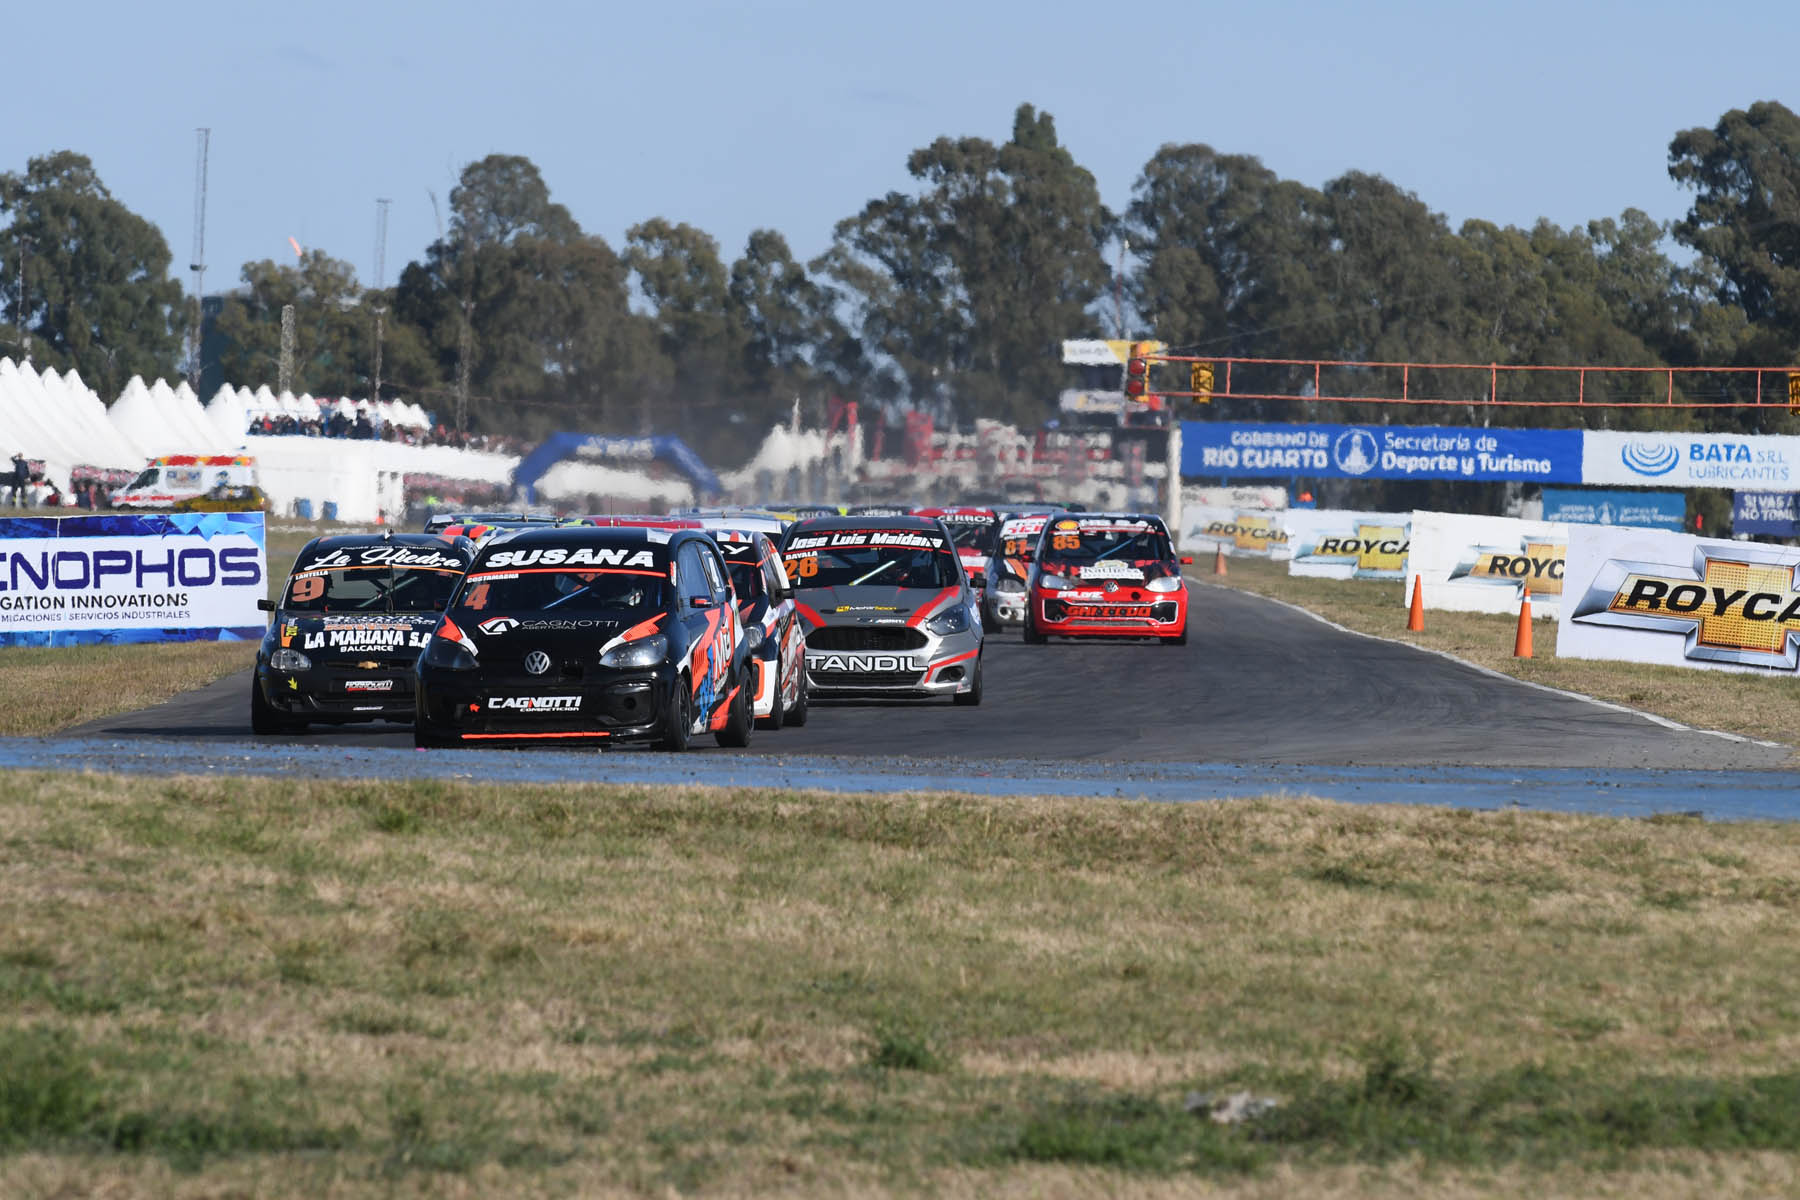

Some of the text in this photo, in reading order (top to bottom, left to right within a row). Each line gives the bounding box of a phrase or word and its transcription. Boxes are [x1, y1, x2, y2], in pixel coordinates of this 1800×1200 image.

[1308, 433, 1329, 448] DE
[1475, 435, 1498, 452] de
[1242, 449, 1328, 468] CUARTO
[1689, 443, 1752, 462] BATA
[1381, 451, 1552, 475] Deporte y Turismo
[1688, 465, 1790, 481] LUBRICANTES
[1758, 494, 1784, 509] VAS
[1738, 508, 1760, 521] NO
[787, 532, 944, 551] Jose Luis Maidana
[1052, 535, 1081, 550] 85
[304, 549, 352, 571] La
[485, 548, 654, 568] SUSANA
[0, 547, 262, 592] NOPHOS
[783, 556, 819, 581] 26
[291, 576, 325, 602] 9
[463, 583, 490, 610] 4
[72, 592, 188, 609] INNOVATIONS
[69, 611, 119, 621] SERVICIOS
[121, 610, 190, 620] INDUSTRIALES
[521, 620, 619, 628] CAGNOTTI
[304, 632, 325, 650] LA
[329, 630, 404, 647] MARIANA
[340, 645, 394, 653] BALCARCE
[805, 655, 928, 672] TANDIL
[488, 696, 582, 709] CAGNOTTI
